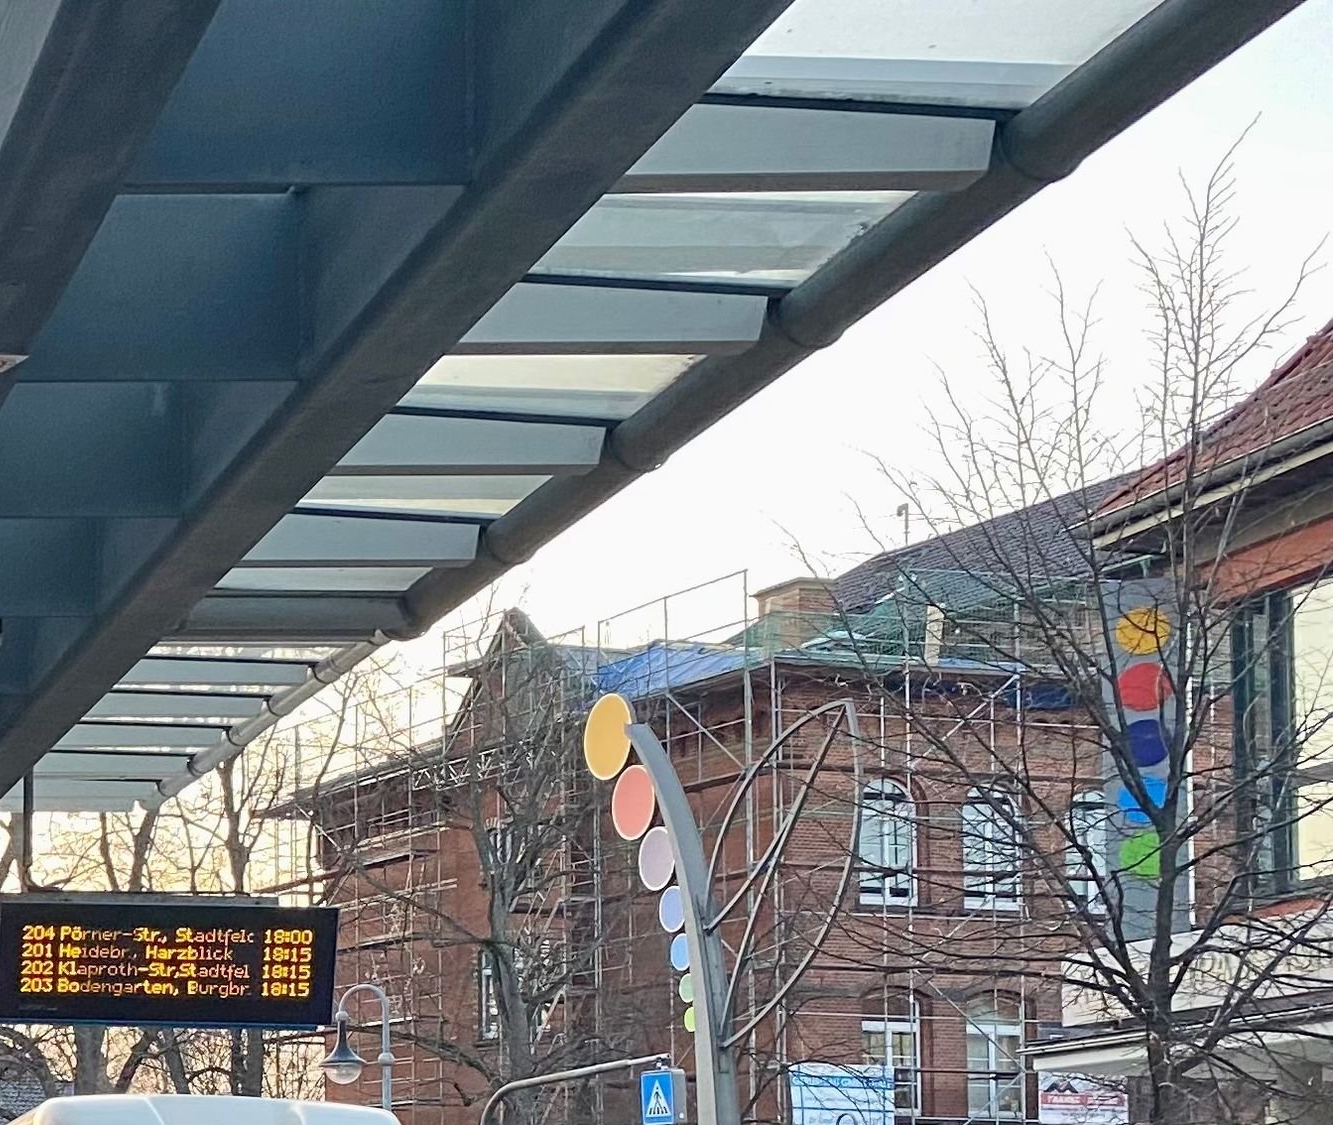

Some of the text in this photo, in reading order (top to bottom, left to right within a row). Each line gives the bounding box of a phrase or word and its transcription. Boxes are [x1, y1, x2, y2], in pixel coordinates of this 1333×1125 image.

[22, 924, 56, 941] 204
[263, 928, 313, 945] 18:00
[21, 942, 53, 959] 201
[145, 944, 233, 961] Harzblick
[262, 946, 312, 963] 18:15
[20, 959, 54, 976] 202
[261, 963, 311, 980] 18:15
[19, 976, 54, 993] 203
[56, 976, 180, 997] Bodengarten,
[260, 981, 310, 997] 18:15
